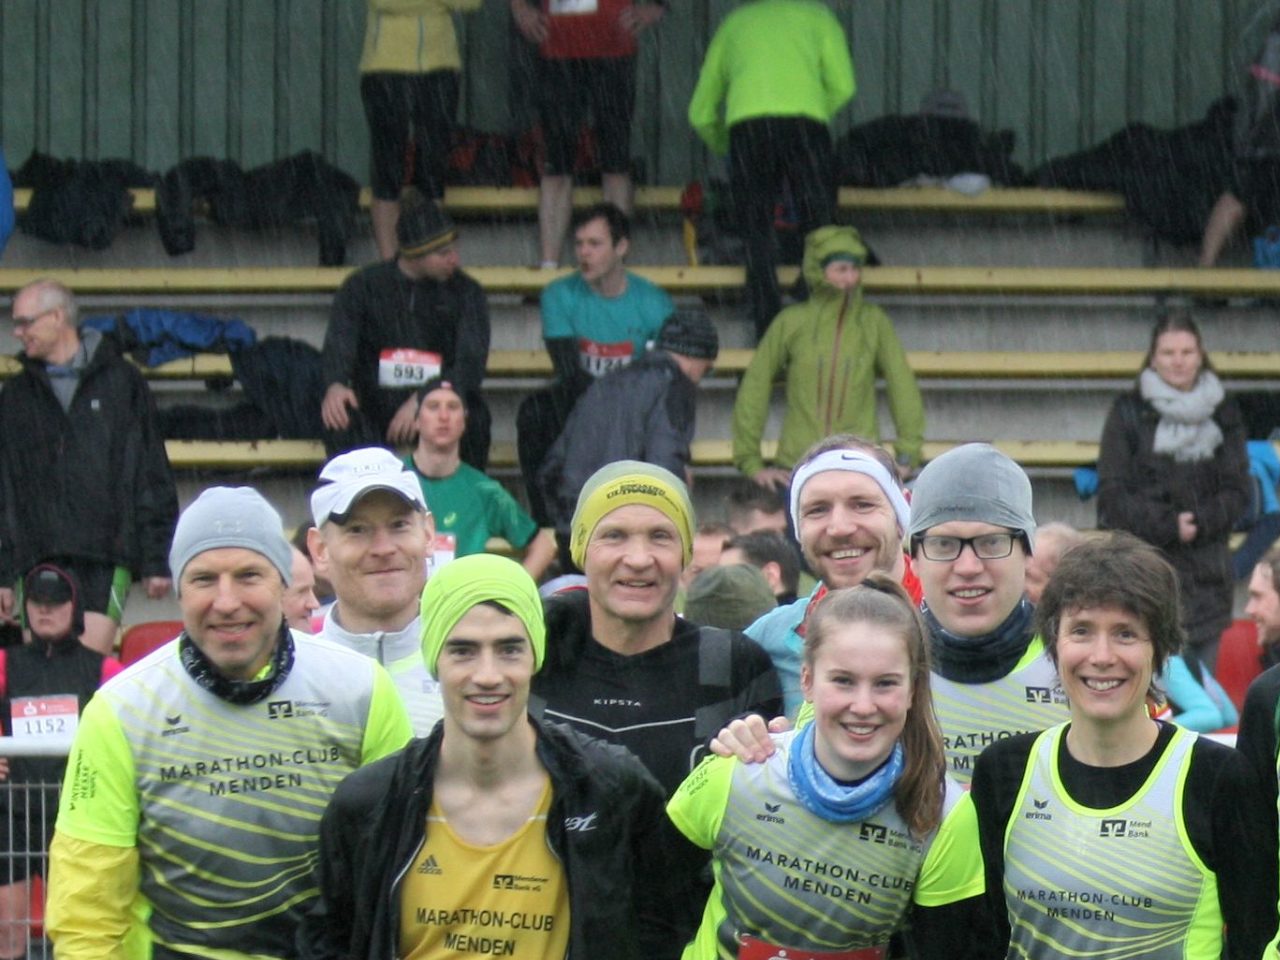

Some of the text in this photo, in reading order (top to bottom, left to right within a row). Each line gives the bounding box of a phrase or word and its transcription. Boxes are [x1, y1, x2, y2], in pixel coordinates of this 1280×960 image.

[25, 718, 65, 734] 1152
[160, 747, 340, 781] MARATHON-CLUB
[209, 773, 302, 796] MENDEN
[756, 813, 785, 825] erima
[1025, 812, 1052, 820] erima
[746, 845, 915, 893] MARATHON-CLUB
[784, 875, 872, 905] MENDEN
[1017, 889, 1153, 908] MARATHON-CLUB
[416, 907, 554, 932] MARATHON-CLUB
[1047, 907, 1115, 921] MENDEN
[444, 933, 516, 956] MENDEN
